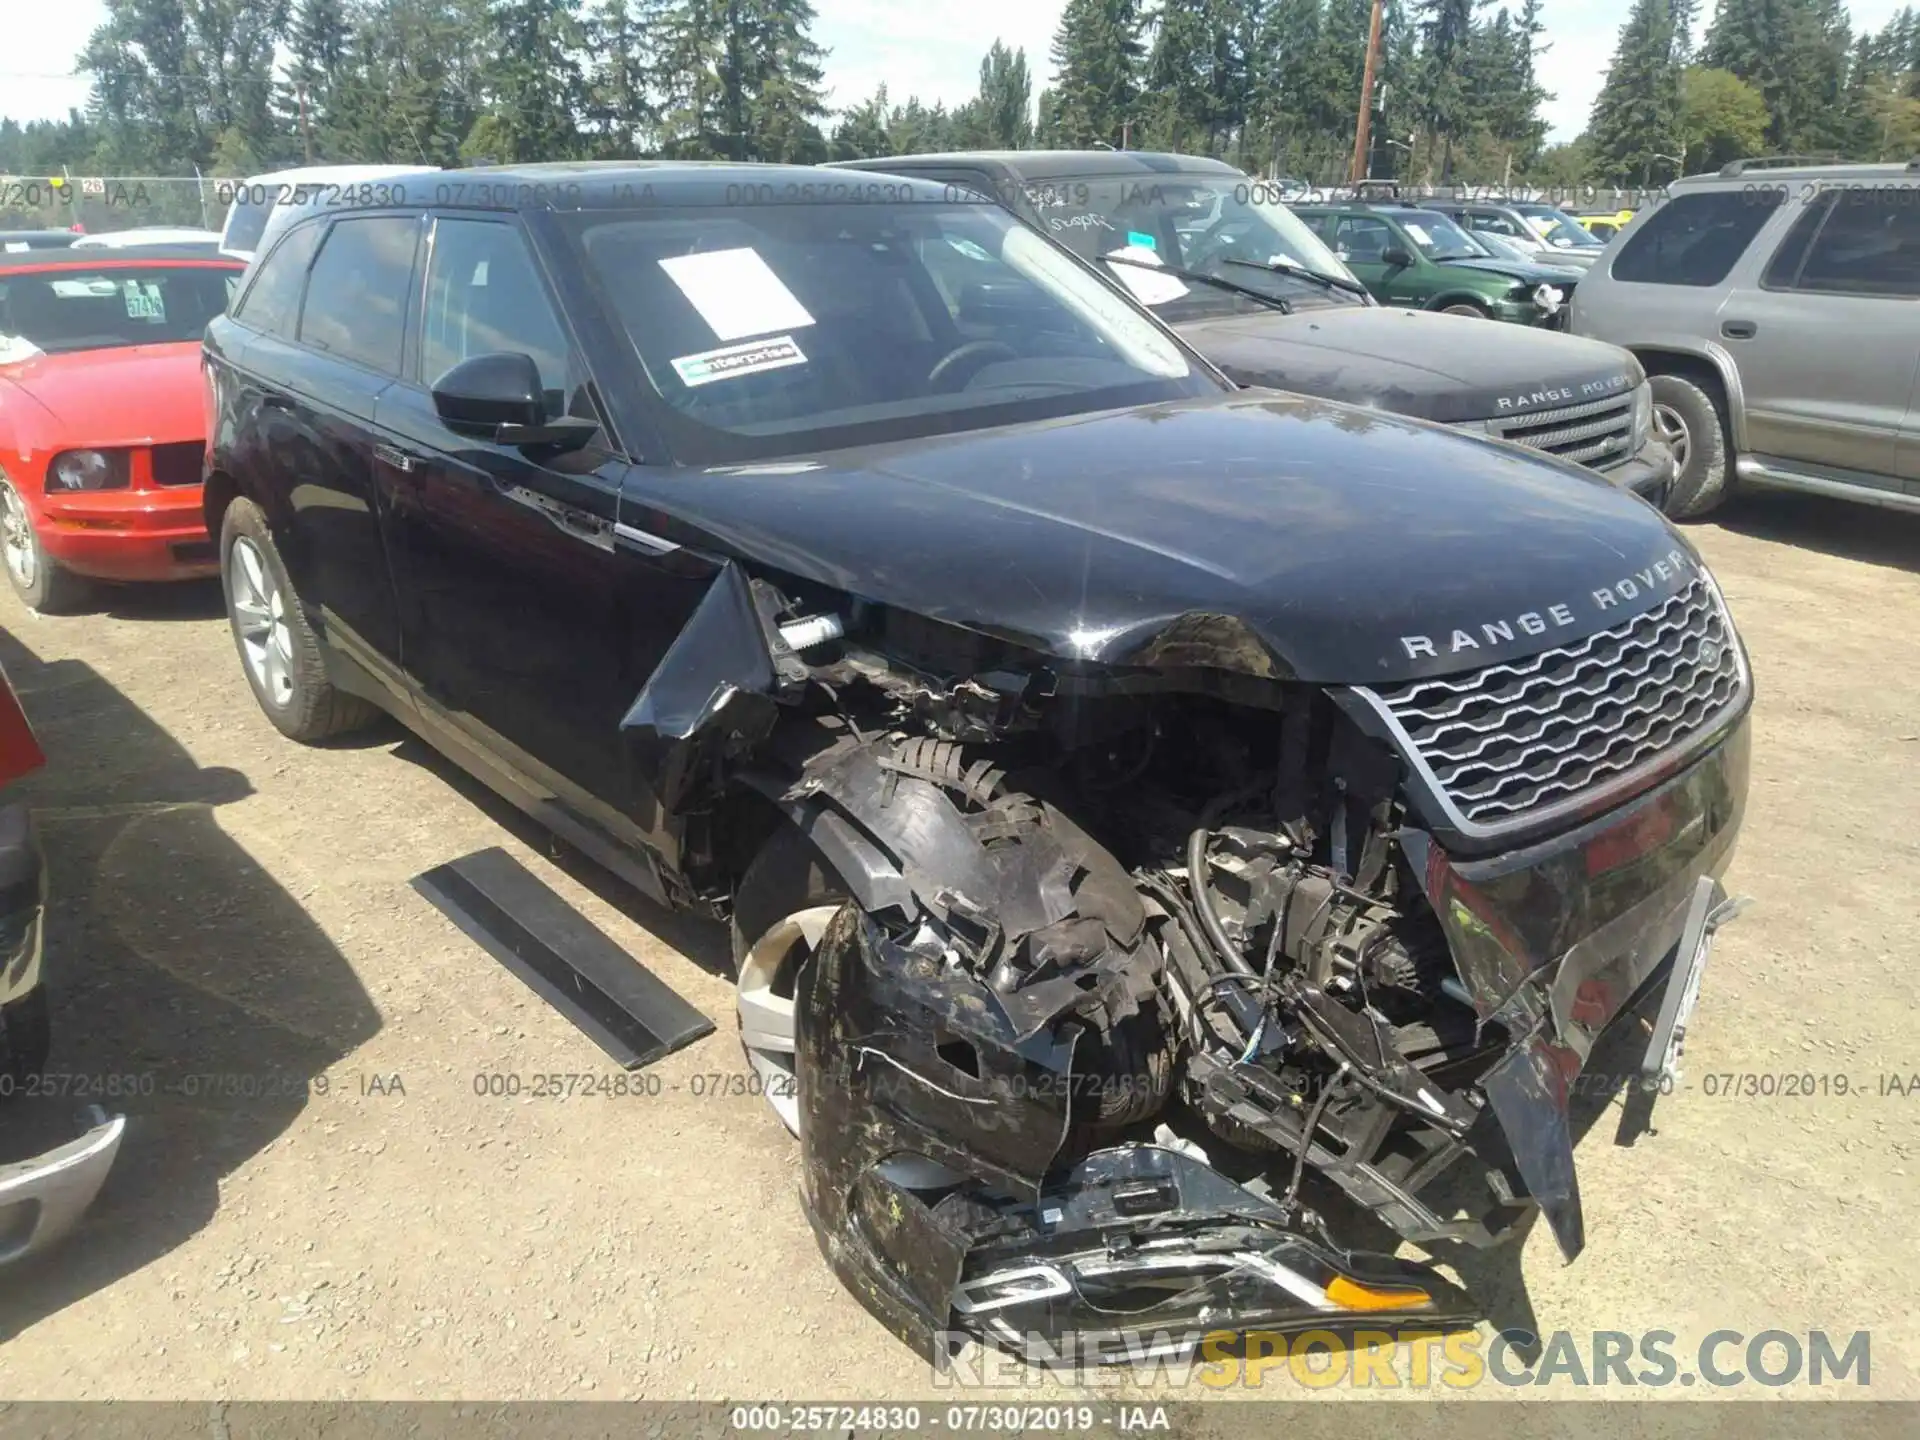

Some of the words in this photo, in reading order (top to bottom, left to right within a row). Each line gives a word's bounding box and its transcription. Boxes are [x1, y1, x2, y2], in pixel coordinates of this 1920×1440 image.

[1497, 387, 1573, 409] RANGE
[1581, 375, 1630, 396] ROVER
[1401, 603, 1575, 659] RANGE
[1592, 549, 1687, 610] ROVER
